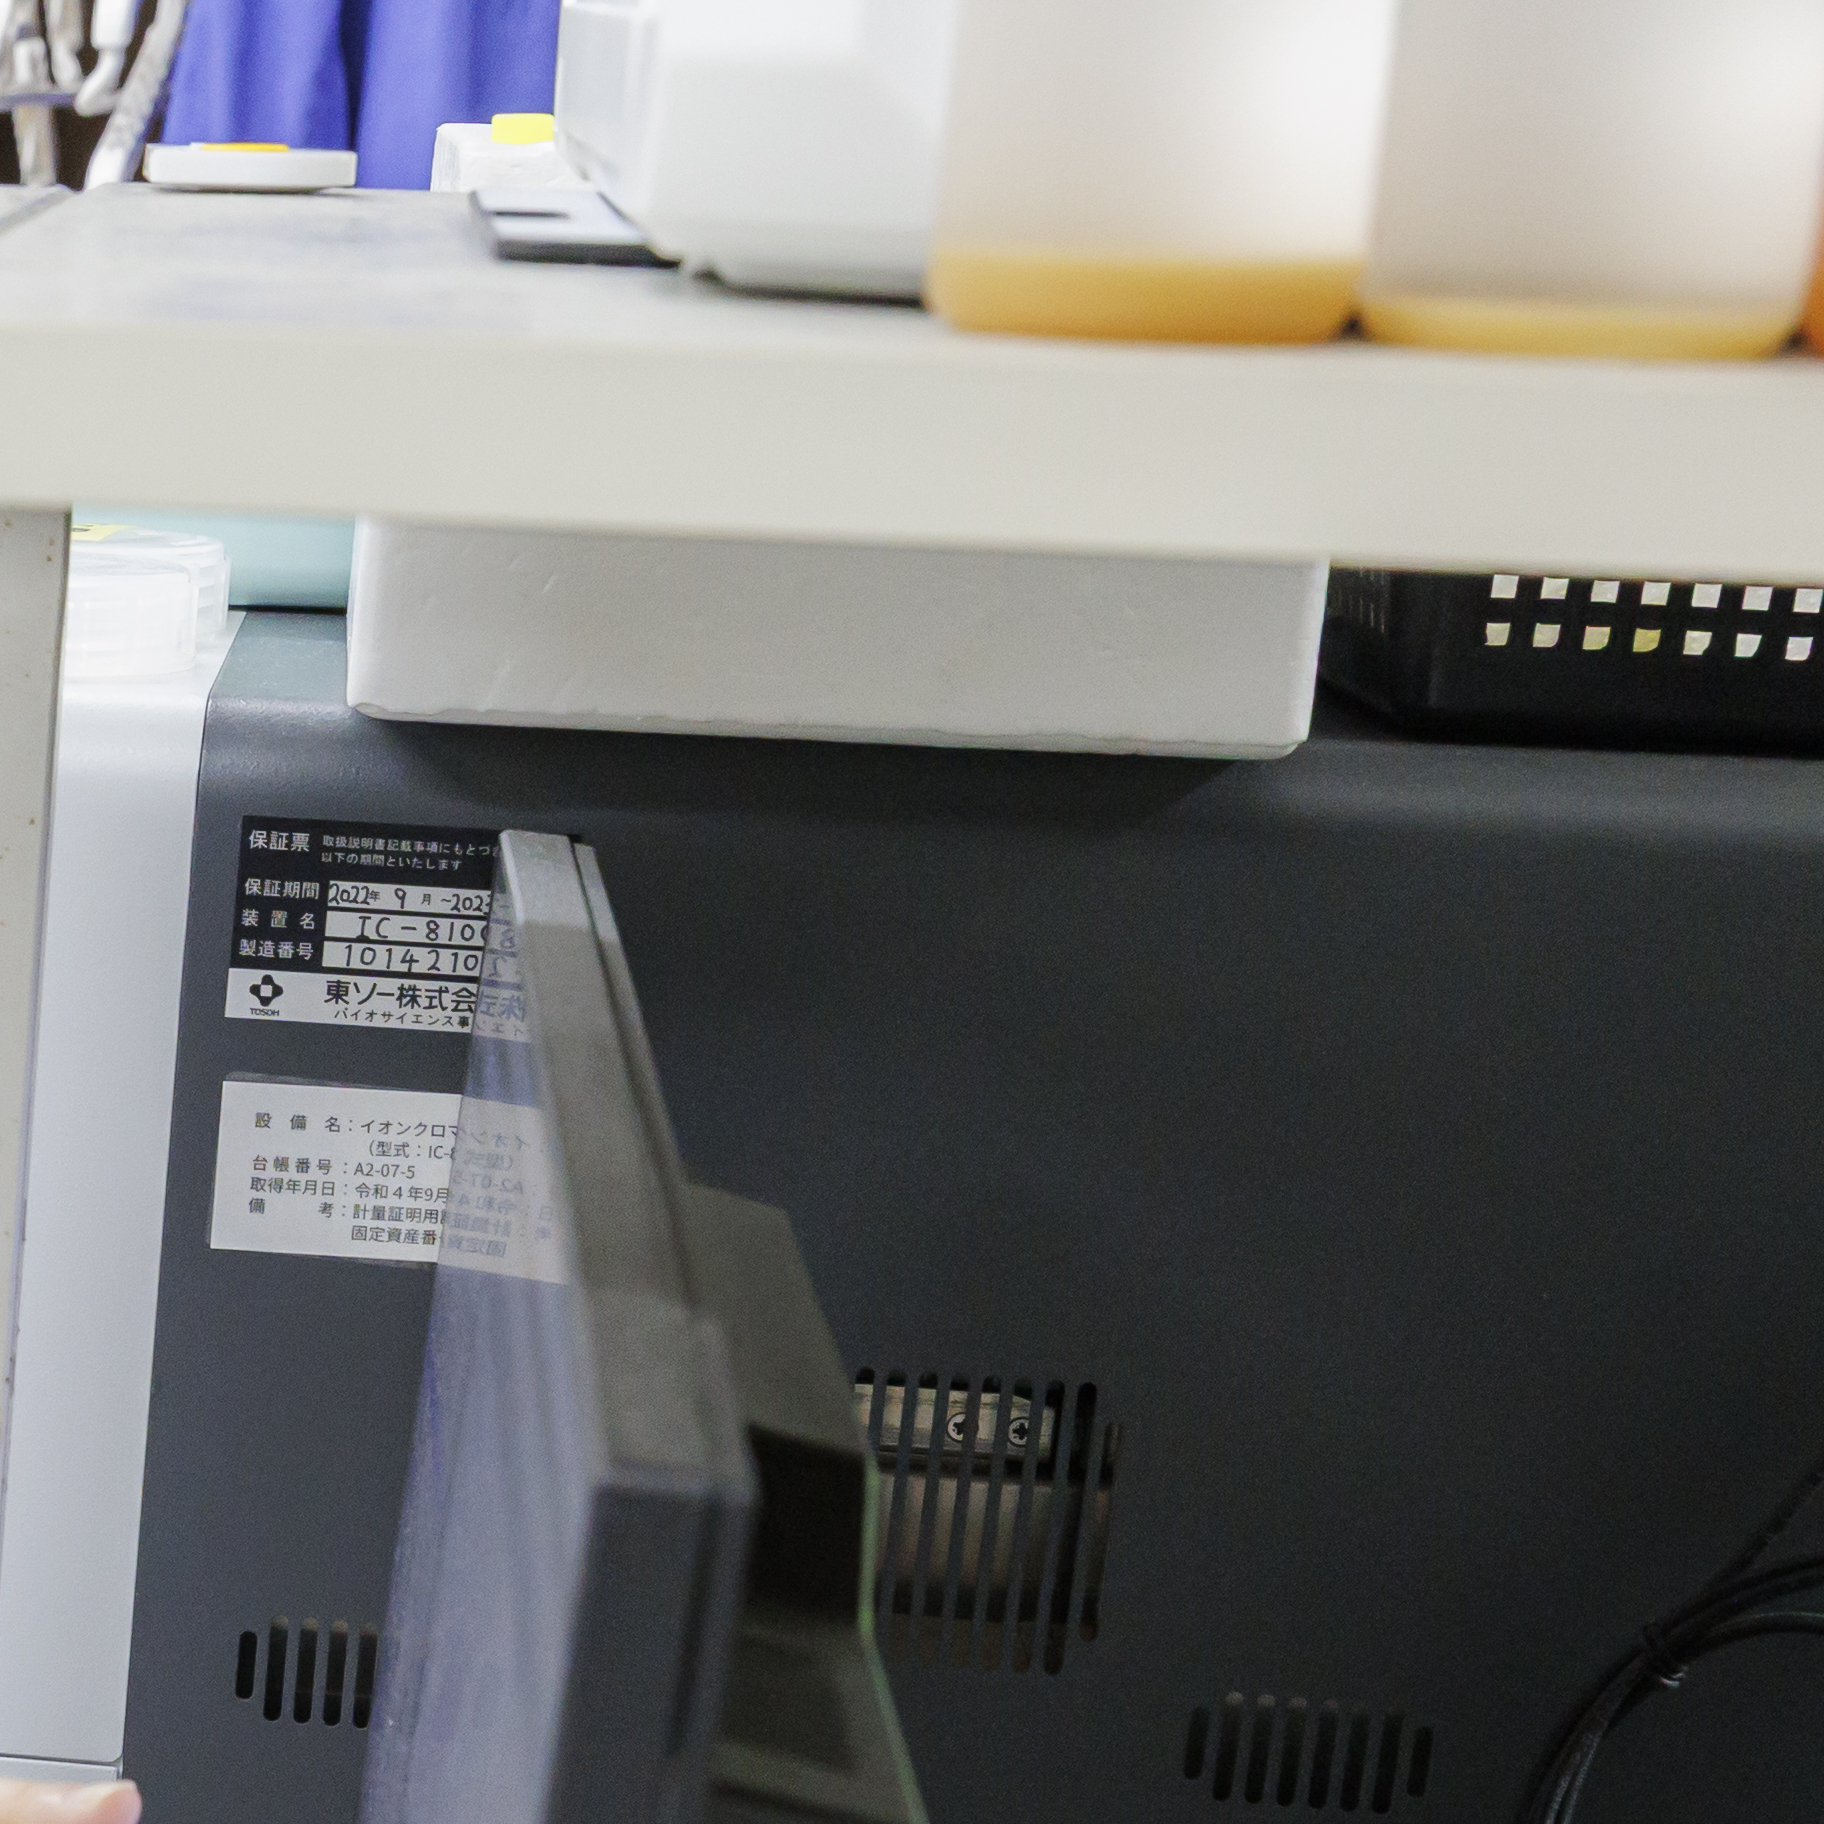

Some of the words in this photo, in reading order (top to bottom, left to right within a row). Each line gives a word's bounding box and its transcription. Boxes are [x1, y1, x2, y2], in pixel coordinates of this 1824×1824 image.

[248, 829, 311, 852] 保証票
[244, 878, 320, 900] 保証期間
[238, 938, 314, 961] 製造番号
[323, 979, 477, 1014] 東ソー株式会
[249, 1007, 280, 1017] TOSOH
[353, 1162, 415, 1180] A2-07-5
[351, 1225, 442, 1247] 固定資産番
